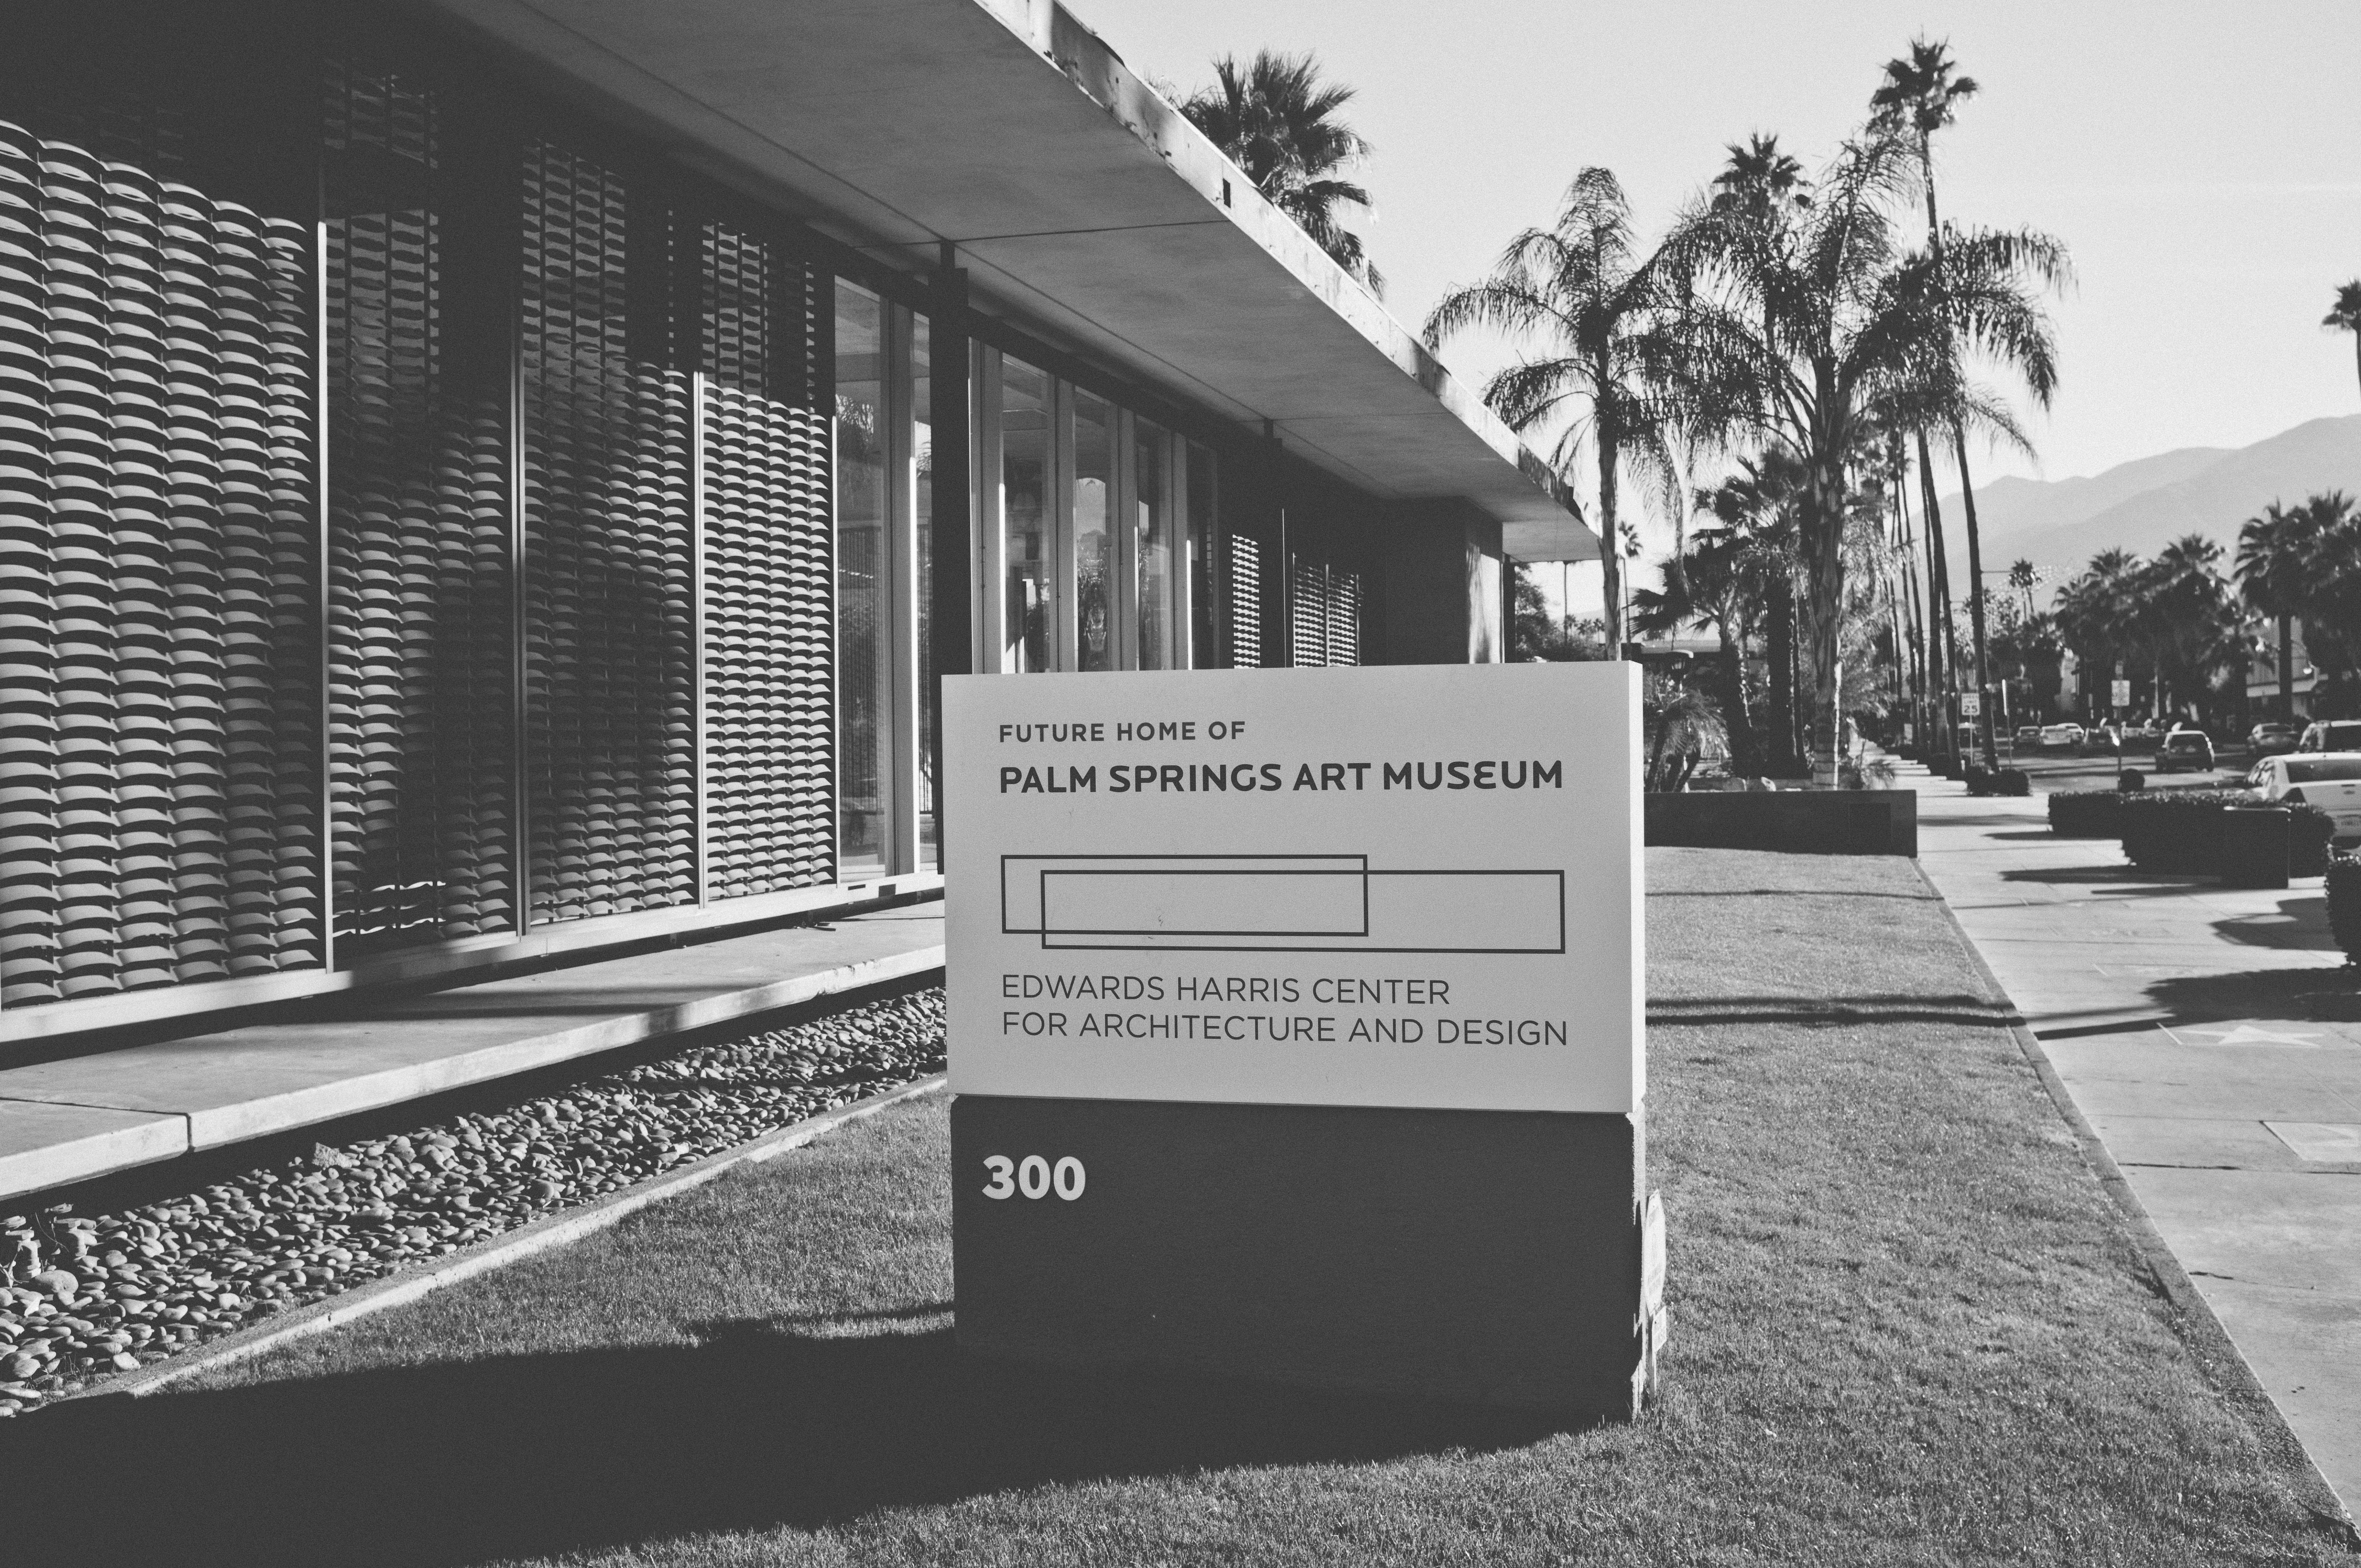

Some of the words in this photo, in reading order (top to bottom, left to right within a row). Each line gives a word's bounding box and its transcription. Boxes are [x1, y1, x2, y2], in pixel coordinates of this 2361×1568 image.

[1964, 705, 1978, 714] 25
[1000, 723, 1104, 742] FUTURE
[1117, 722, 1195, 741] HOME
[1209, 721, 1245, 740] OF
[1000, 766, 1096, 793] PALM
[1109, 764, 1282, 793] SPRINGS
[1293, 763, 1371, 791] ART
[1383, 760, 1563, 790] MUSEUM
[1003, 974, 1164, 1000] EDWARDS
[1178, 977, 1299, 1003] HARRIS
[1313, 978, 1449, 1005] CENTER
[1004, 1011, 1067, 1036] FOR
[1080, 1014, 1335, 1042] ARCHITECTURE
[1349, 1018, 1423, 1043] AND
[1438, 1019, 1566, 1046] DESIGN
[982, 1155, 1086, 1201] 300
